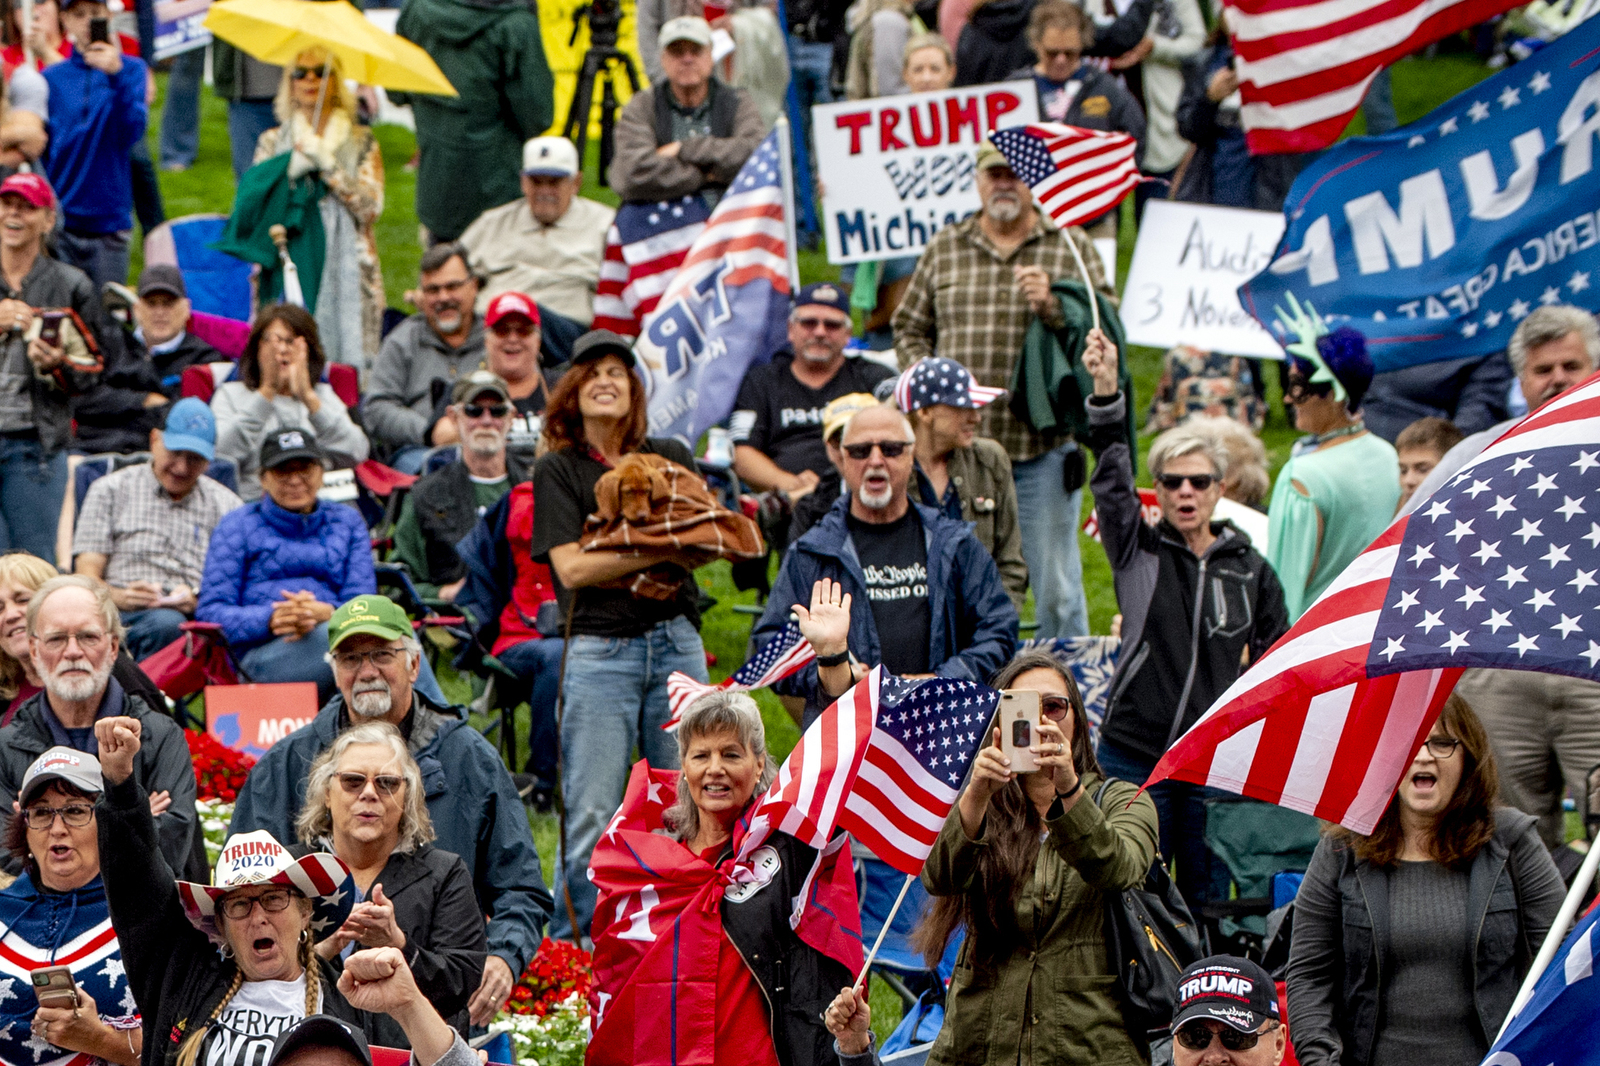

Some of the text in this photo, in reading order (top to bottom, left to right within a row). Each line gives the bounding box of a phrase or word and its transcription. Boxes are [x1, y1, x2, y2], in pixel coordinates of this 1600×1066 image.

[834, 91, 1021, 155] TRUMP
[1179, 217, 1271, 275] Audi
[1139, 282, 1164, 326] 3
[224, 841, 283, 864] TRUMP
[231, 854, 275, 872] 2020
[1179, 974, 1253, 1002] TRUMP
